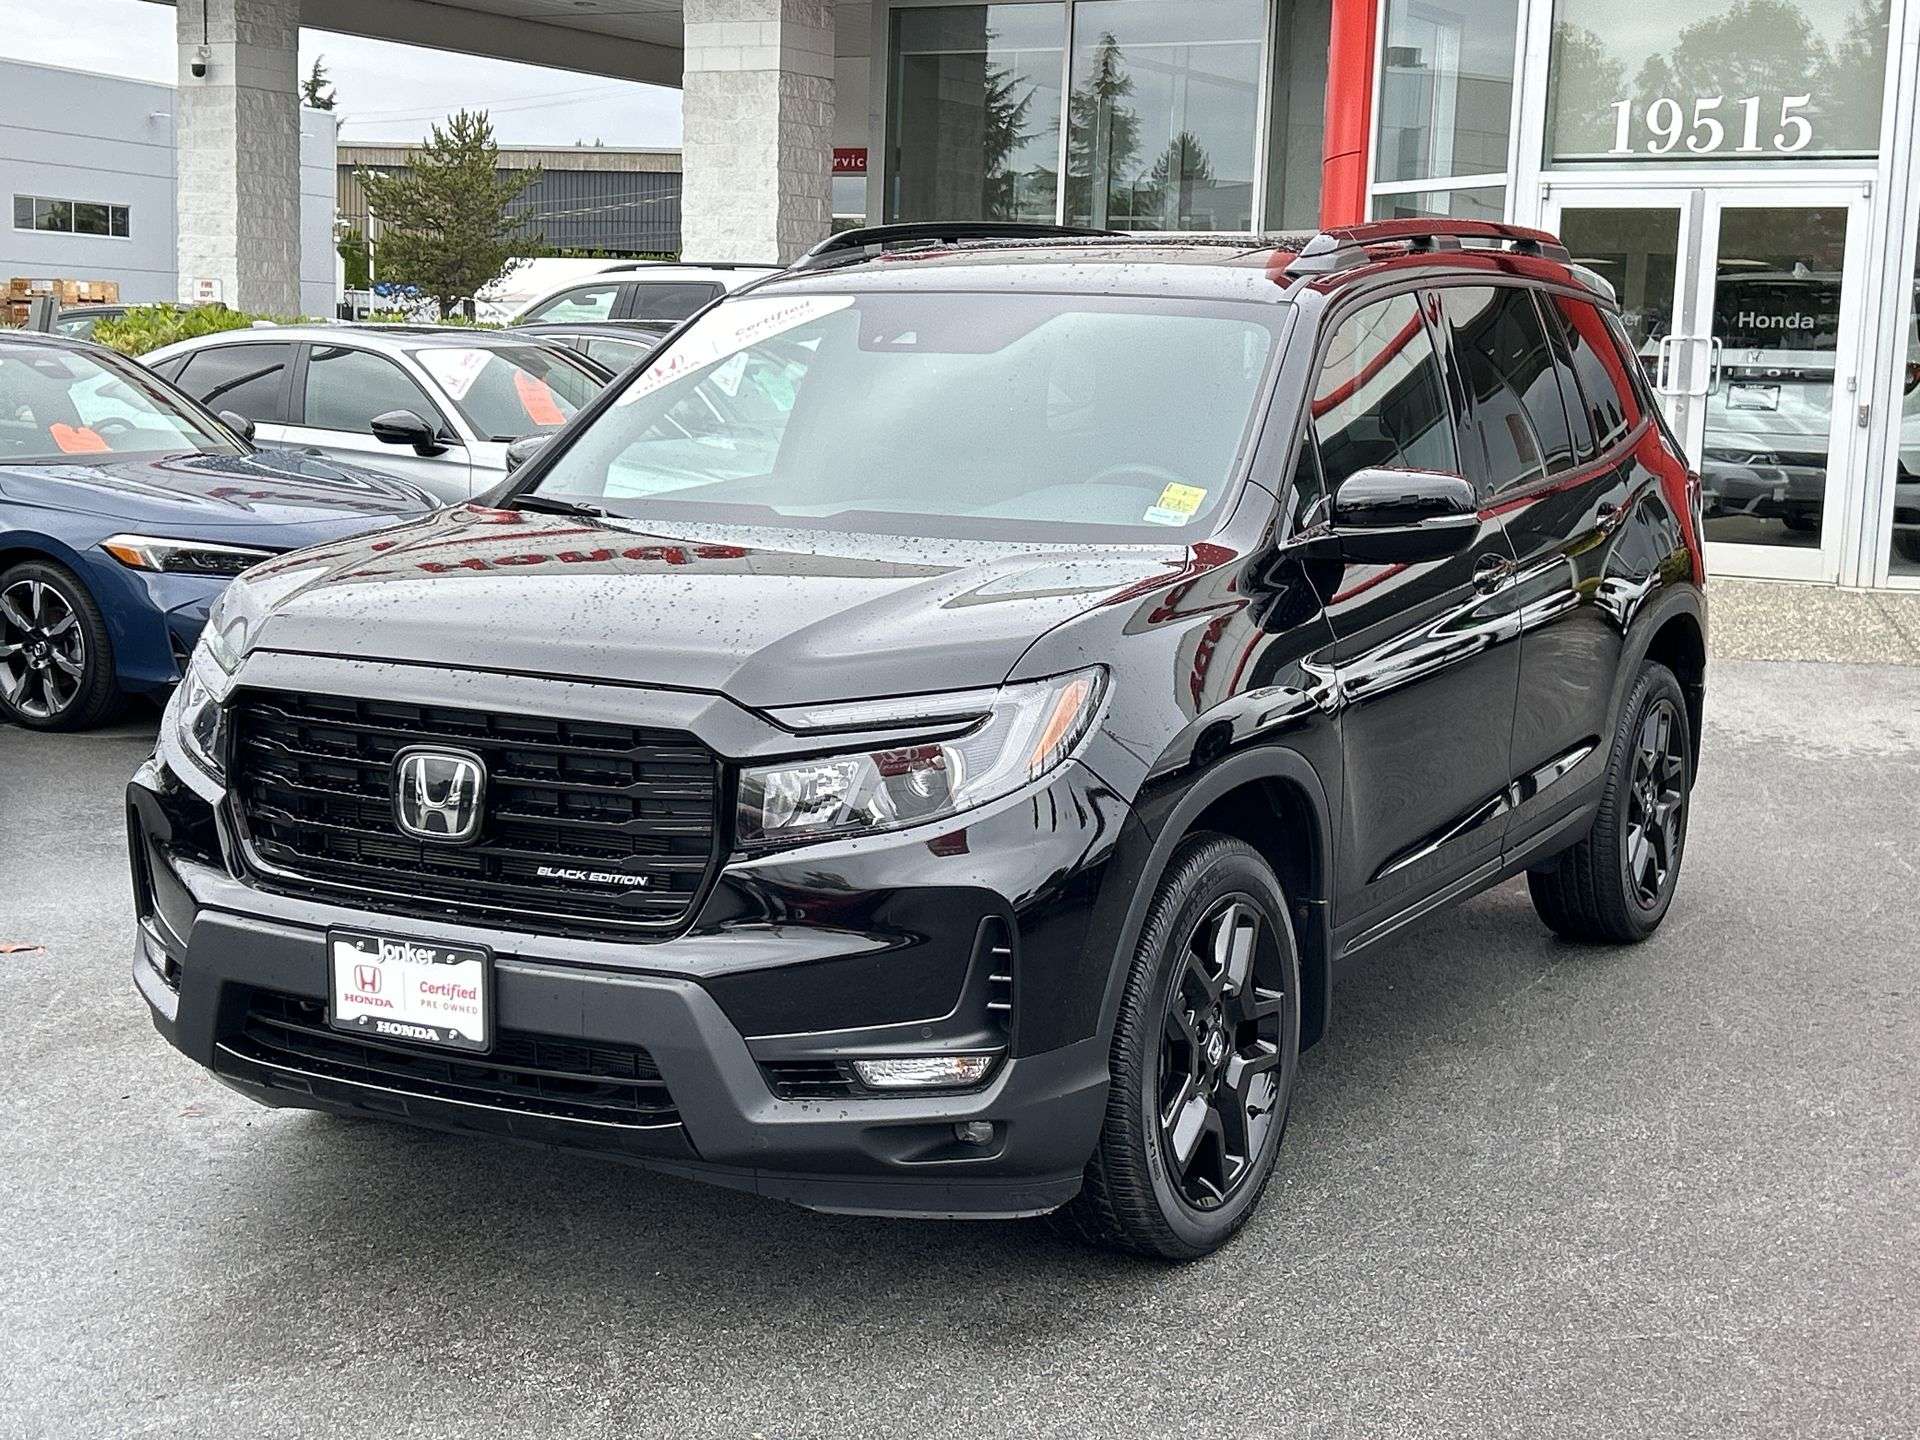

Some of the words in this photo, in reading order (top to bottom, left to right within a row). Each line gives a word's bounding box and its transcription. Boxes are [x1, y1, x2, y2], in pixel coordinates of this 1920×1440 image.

[1608, 93, 1813, 154] 19515
[834, 154, 865, 167] rvic
[1738, 311, 1815, 330] Honda
[537, 866, 587, 880] BLACK
[588, 872, 648, 886] EDITION
[377, 937, 436, 965] Jonker
[344, 993, 394, 1009] HONDA
[419, 981, 477, 1001] Certified
[376, 1021, 440, 1041] HONDA
